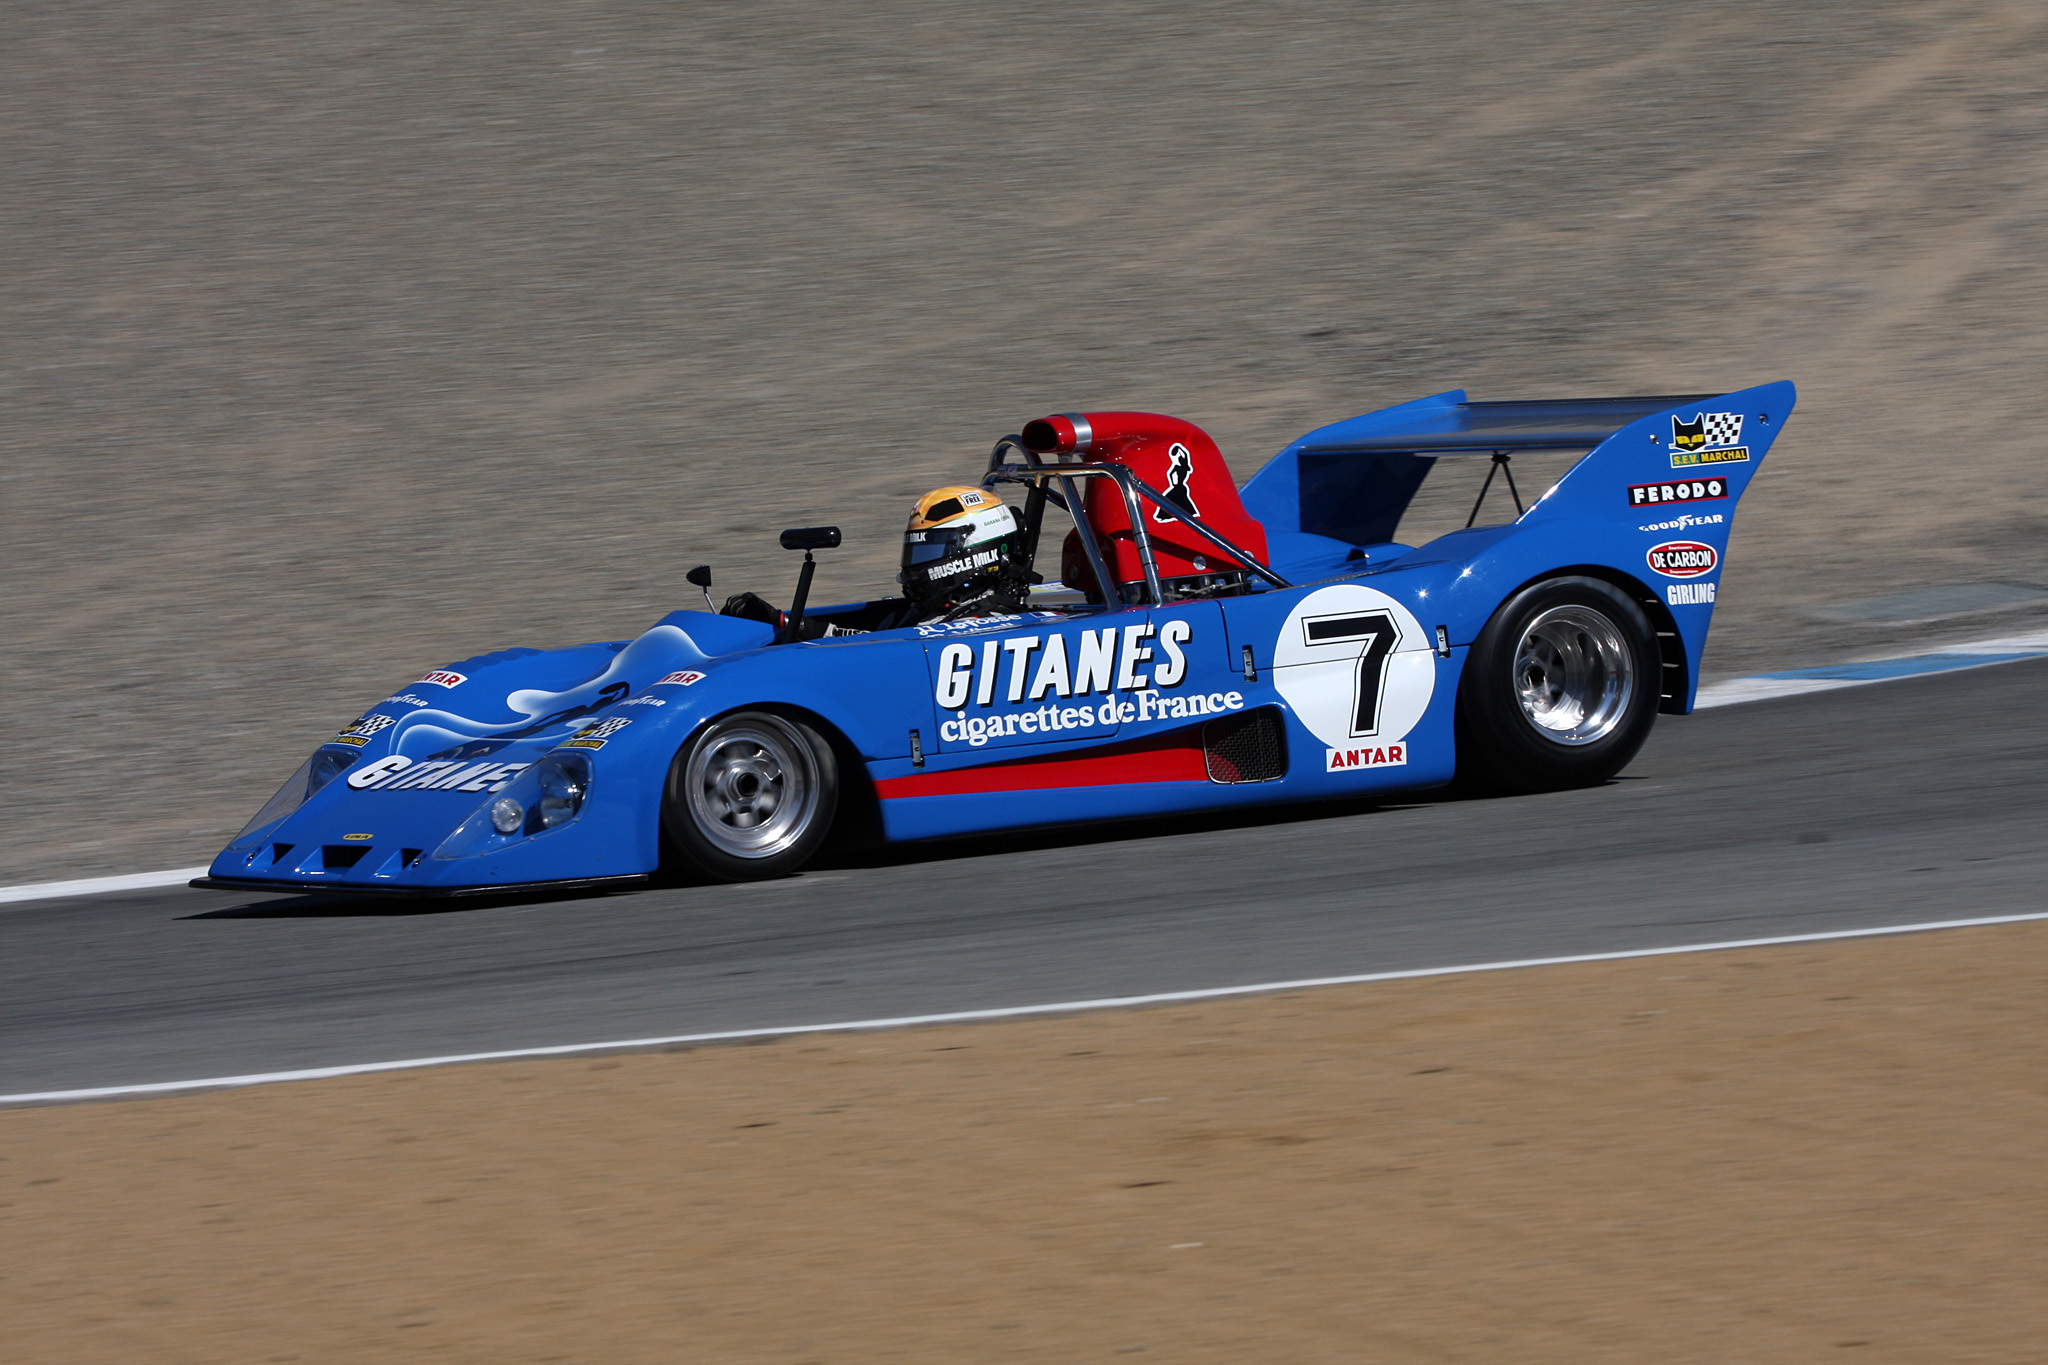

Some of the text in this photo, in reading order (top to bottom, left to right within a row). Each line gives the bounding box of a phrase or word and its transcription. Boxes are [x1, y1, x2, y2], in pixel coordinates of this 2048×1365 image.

[1673, 450, 1747, 465] S.E.V. MARCHAL
[965, 496, 981, 505] FREE
[1633, 480, 1723, 504] FERODO
[1638, 514, 1723, 532] GOODYEAR
[927, 548, 999, 581] MUSCLE MILK
[1652, 550, 1712, 568] DE CARBON
[1666, 582, 1716, 606] GIRLING
[935, 619, 1192, 709] GITANES
[1301, 608, 1404, 738] 7
[940, 688, 1244, 746] cigarettes de France
[1330, 746, 1403, 768] ANTAR
